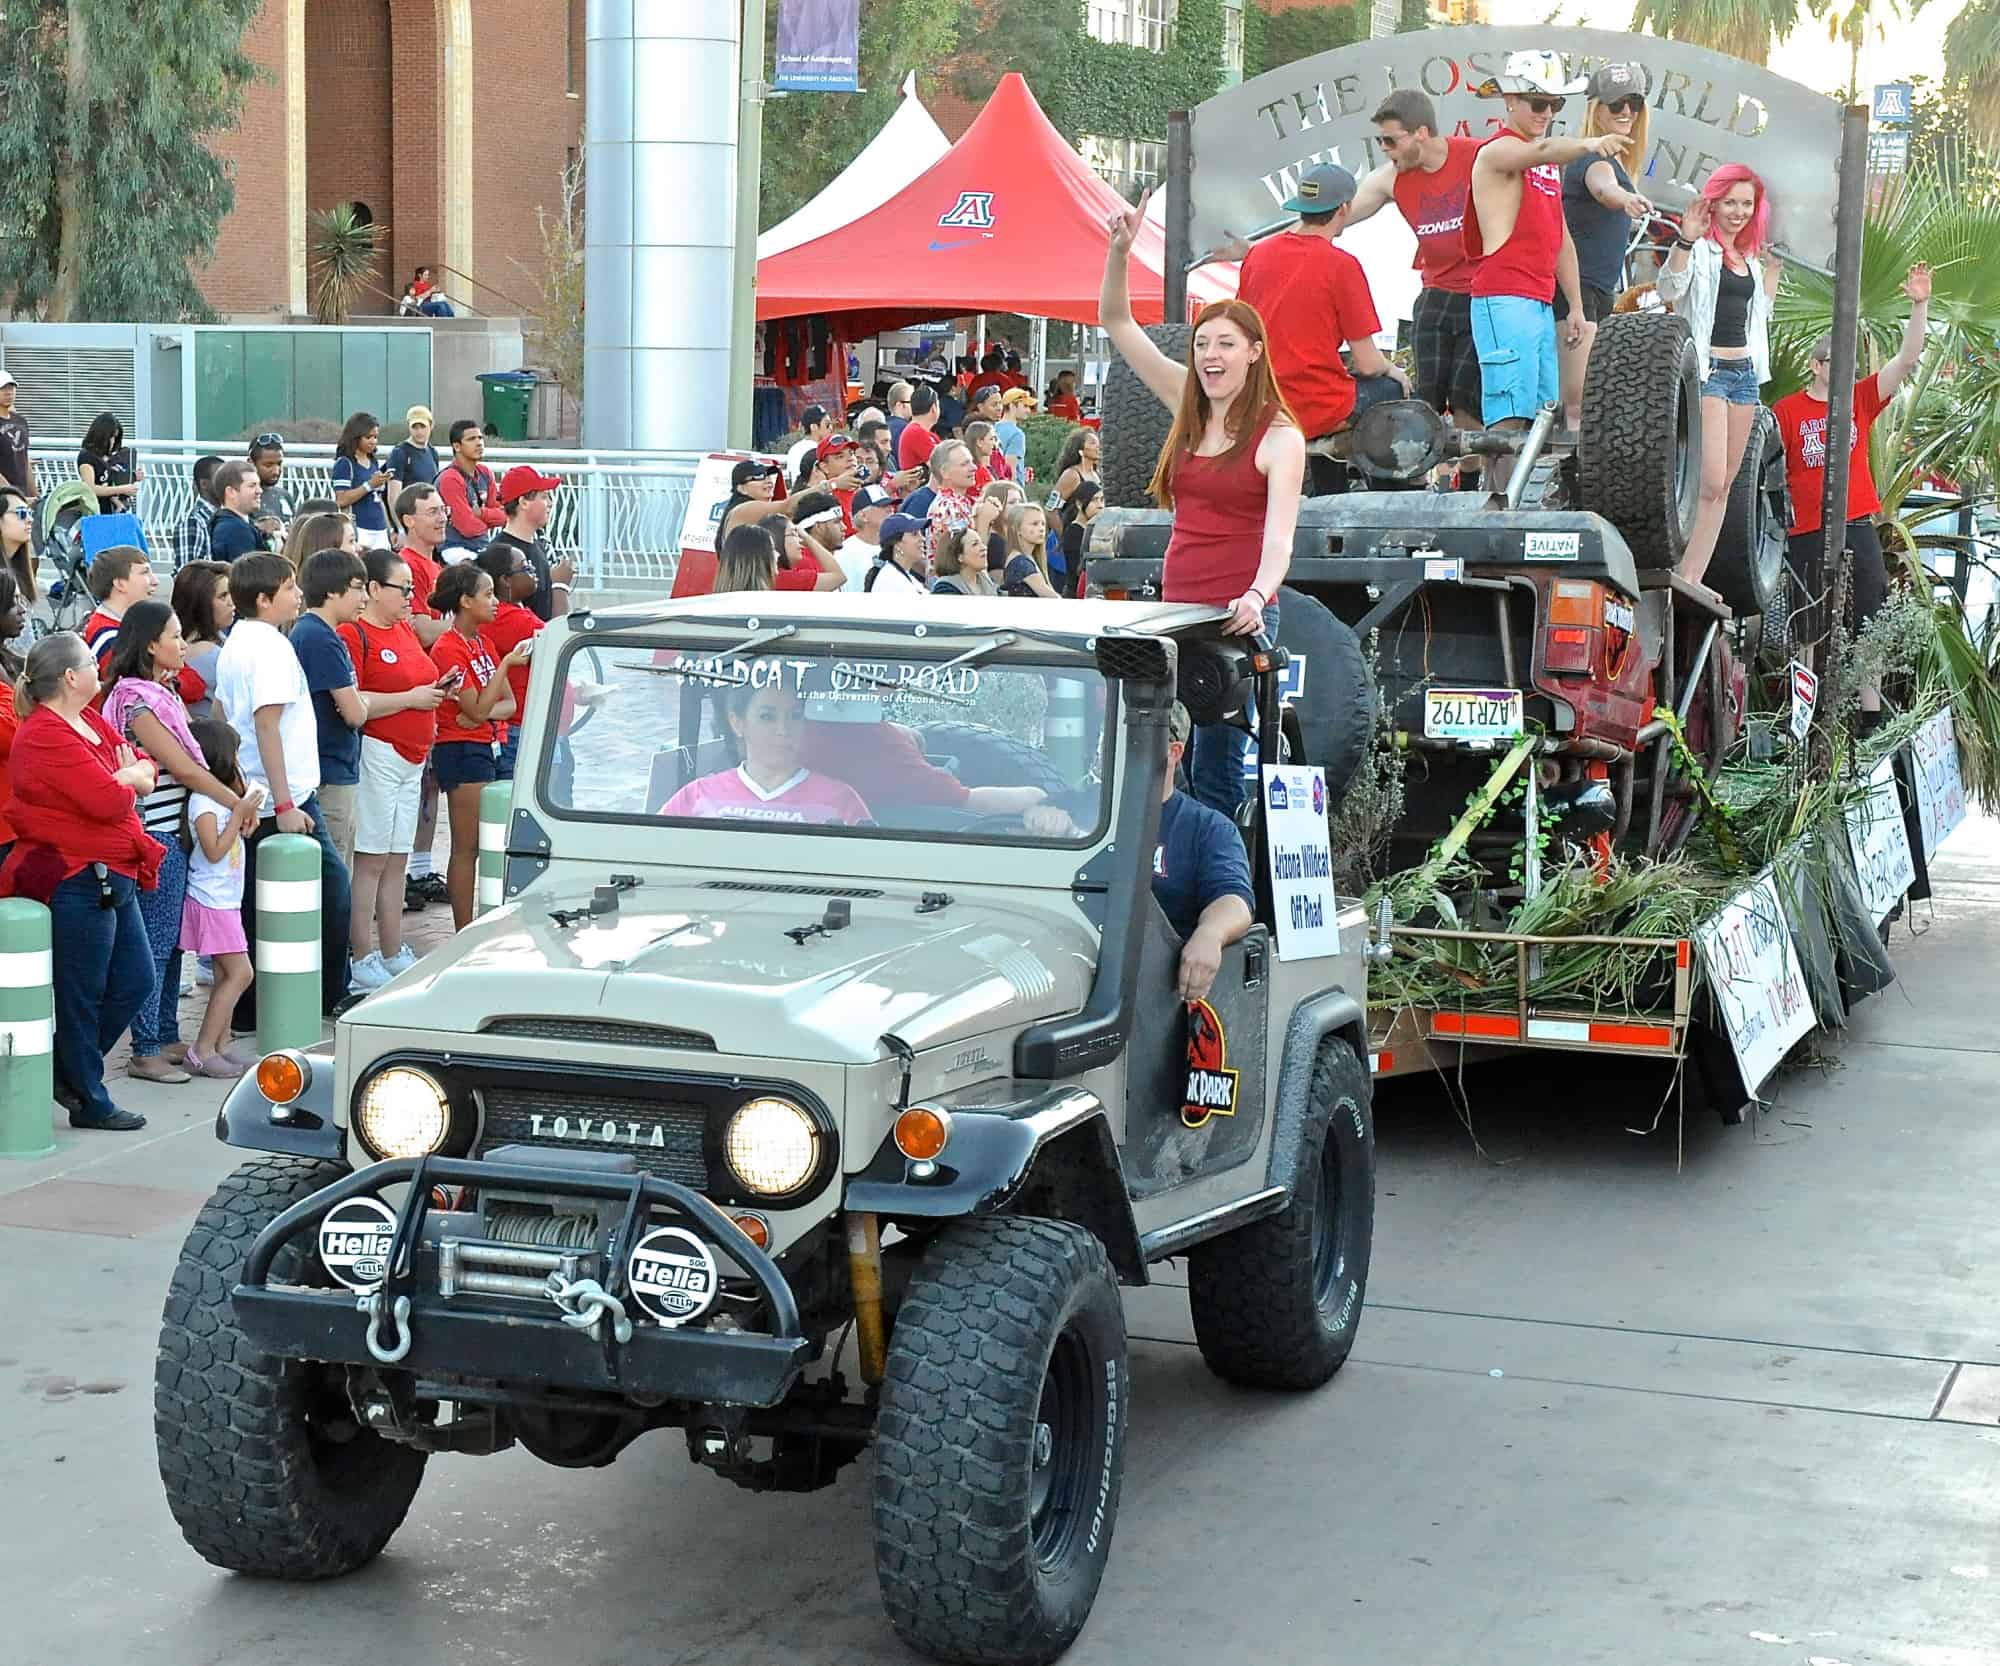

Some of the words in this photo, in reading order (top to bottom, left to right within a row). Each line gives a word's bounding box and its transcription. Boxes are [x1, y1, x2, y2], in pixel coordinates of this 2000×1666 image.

[1256, 74, 1367, 141] THE
[1384, 50, 1516, 98] LOS
[1875, 89, 1906, 117] A
[937, 191, 996, 229] A
[1529, 539, 1575, 551] NATIVE
[809, 690, 826, 700] the
[828, 690, 880, 704] University
[881, 693, 893, 703] of
[1432, 701, 1509, 726] AZR1792
[1274, 844, 1301, 880] Arizona
[1301, 844, 1330, 879] Wildcat
[1290, 895, 1303, 930] Off
[1304, 894, 1324, 929] Road
[1199, 1069, 1233, 1110] PARK
[530, 1114, 665, 1147] TOYOTA
[327, 1232, 393, 1255] Hella
[635, 1260, 706, 1291] Hella
[689, 1259, 706, 1268] 500
